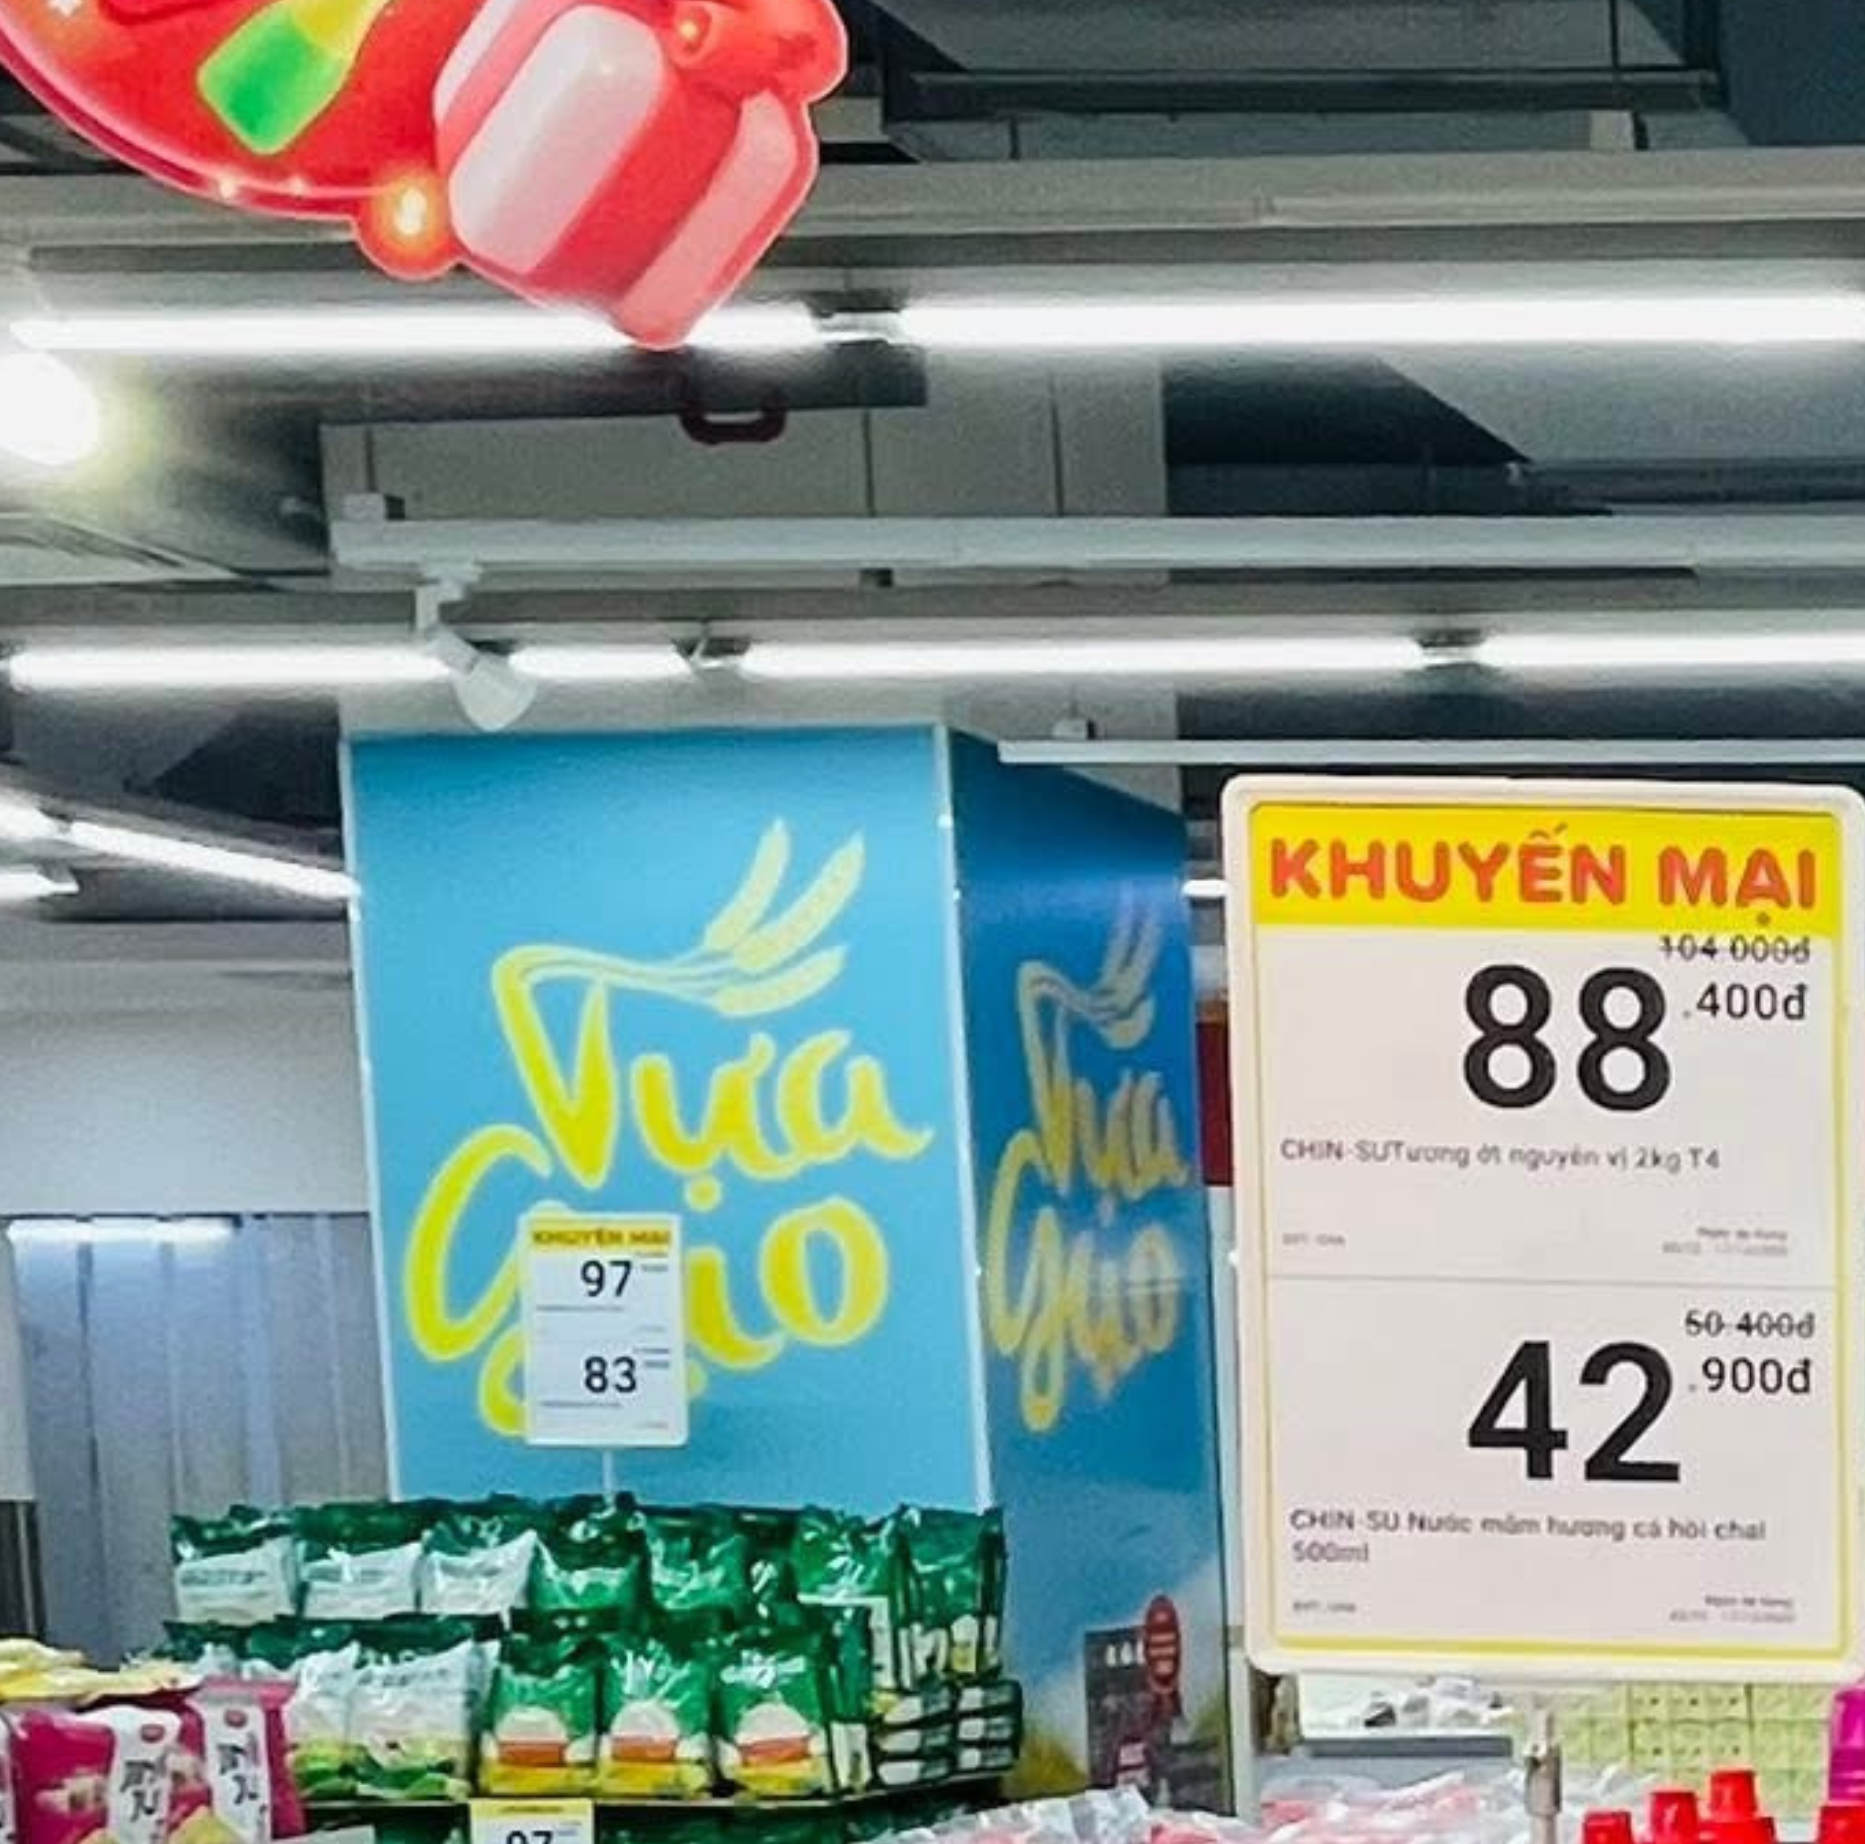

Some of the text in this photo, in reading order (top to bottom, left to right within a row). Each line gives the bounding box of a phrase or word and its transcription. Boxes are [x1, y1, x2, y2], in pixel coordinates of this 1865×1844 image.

[1271, 823, 1816, 926] KHUYẾN MẠI
[1463, 964, 1671, 1111] 88
[580, 1260, 632, 1297] 97
[584, 1356, 637, 1394] 83
[1468, 1341, 1680, 1482] 42
[1715, 1515, 1765, 1539] chai
[1292, 1541, 1369, 1563] 500ml
